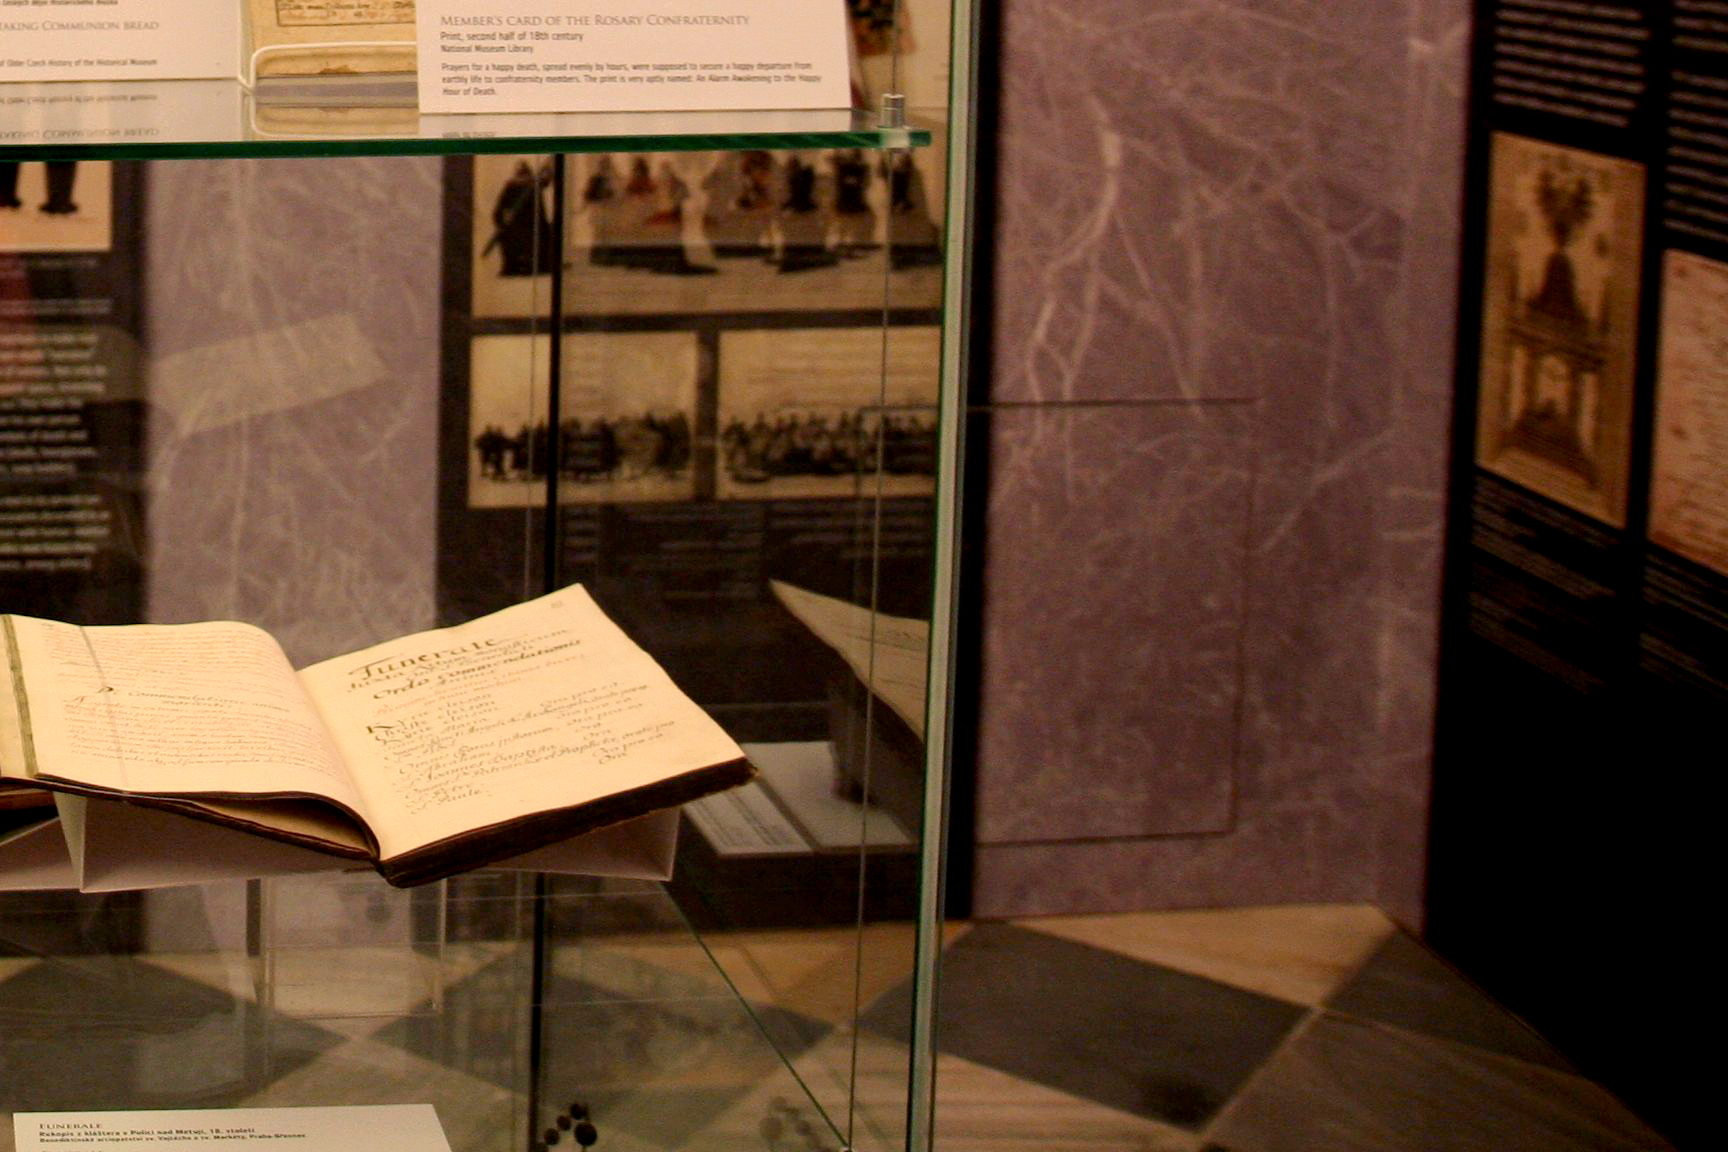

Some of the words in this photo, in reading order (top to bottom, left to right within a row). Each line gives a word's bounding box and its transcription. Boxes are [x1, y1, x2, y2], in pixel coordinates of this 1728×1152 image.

[506, 15, 542, 25] CARD
[544, 15, 562, 25] OF
[566, 15, 590, 25] THE
[595, 14, 643, 25] ROSARY
[646, 14, 750, 25] CONFRATERNITY
[124, 20, 160, 30] BREAD
[466, 31, 496, 41] second
[498, 31, 514, 41] half
[530, 31, 550, 41] 18th
[552, 31, 584, 41] century
